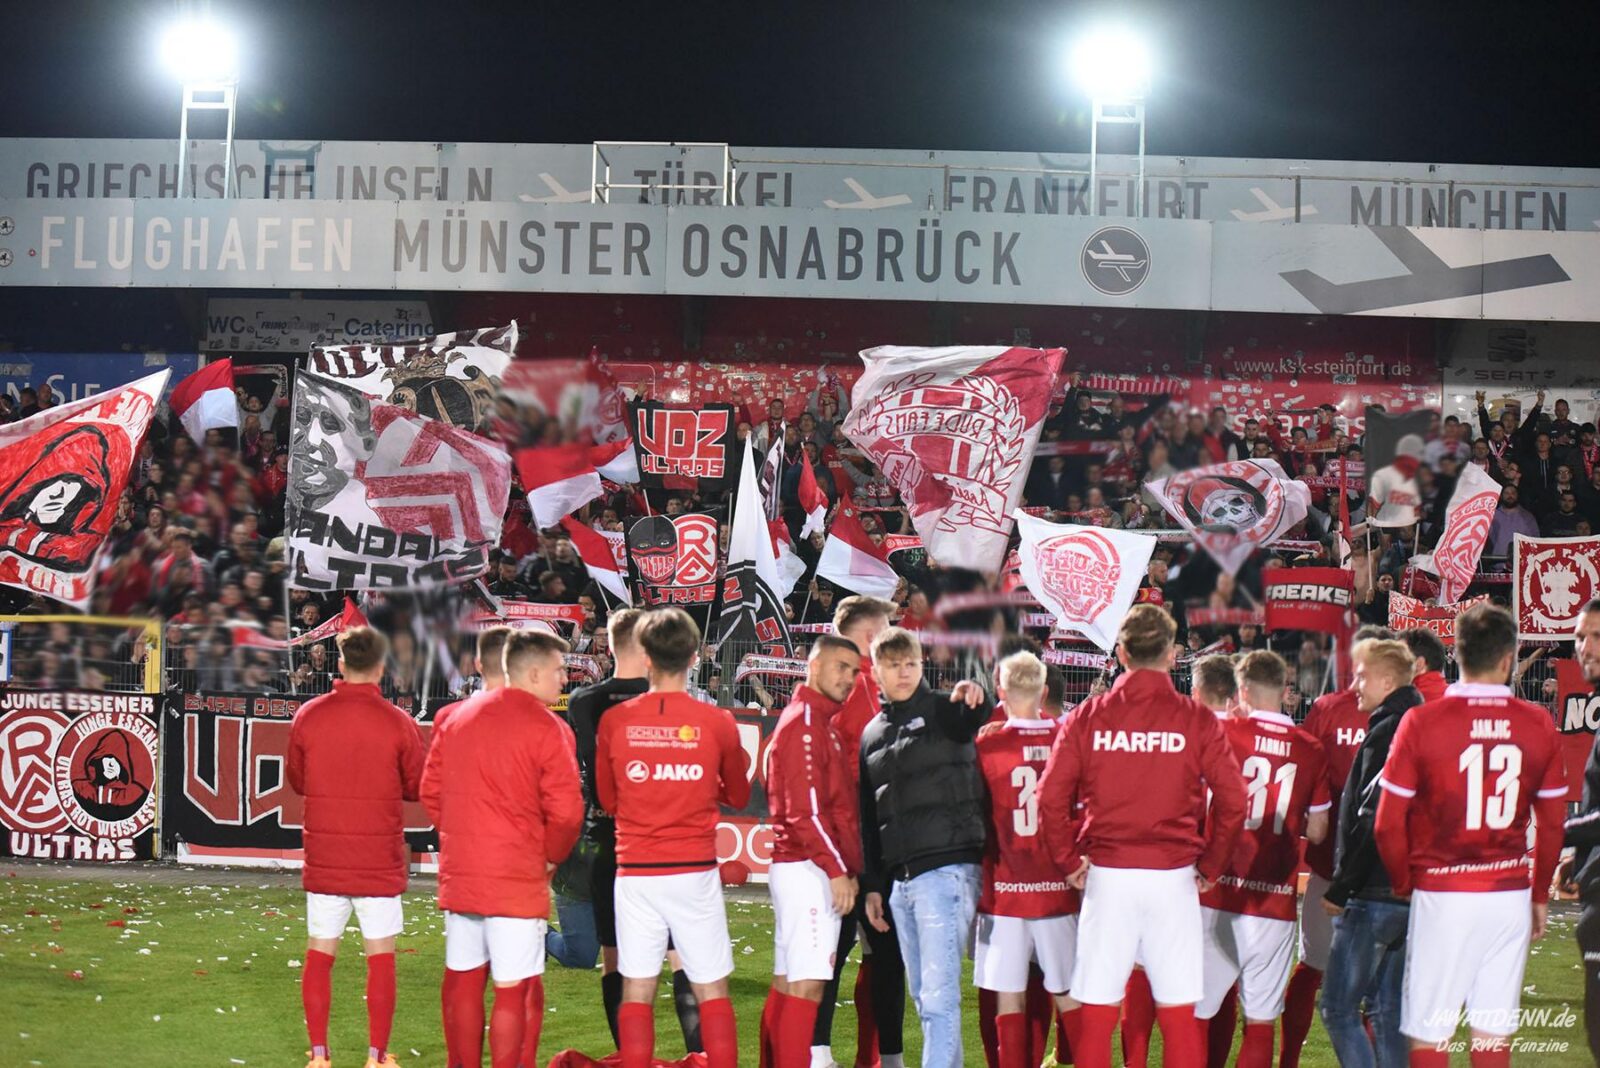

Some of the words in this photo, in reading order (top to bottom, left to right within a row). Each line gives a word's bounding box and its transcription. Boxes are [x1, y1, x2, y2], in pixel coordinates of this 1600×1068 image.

[40, 216, 353, 272] FLUGHAFEN
[394, 209, 652, 277] MÜNSTER
[682, 217, 1022, 286] OSNABRÜCK
[208, 316, 246, 334] WC
[1474, 369, 1540, 381] SEAT
[641, 453, 726, 479] ULTRAS
[637, 583, 717, 606] ULTRAS
[1265, 583, 1351, 607] FREAKS
[2, 692, 64, 711] JUNGE
[66, 693, 155, 714] ESSENER
[184, 693, 247, 716] EHRE
[253, 698, 298, 719] DER
[74, 712, 114, 741] JUNGE
[626, 727, 679, 740] SCHULTE
[1092, 730, 1187, 753] HARFID
[652, 763, 704, 781] JAKO
[55, 755, 75, 809] ULTRAS
[70, 806, 94, 832] ROT
[97, 815, 140, 838] WEISS
[1241, 755, 1298, 836] 31
[1459, 743, 1523, 831] 13
[10, 831, 137, 860] ULTRAS
